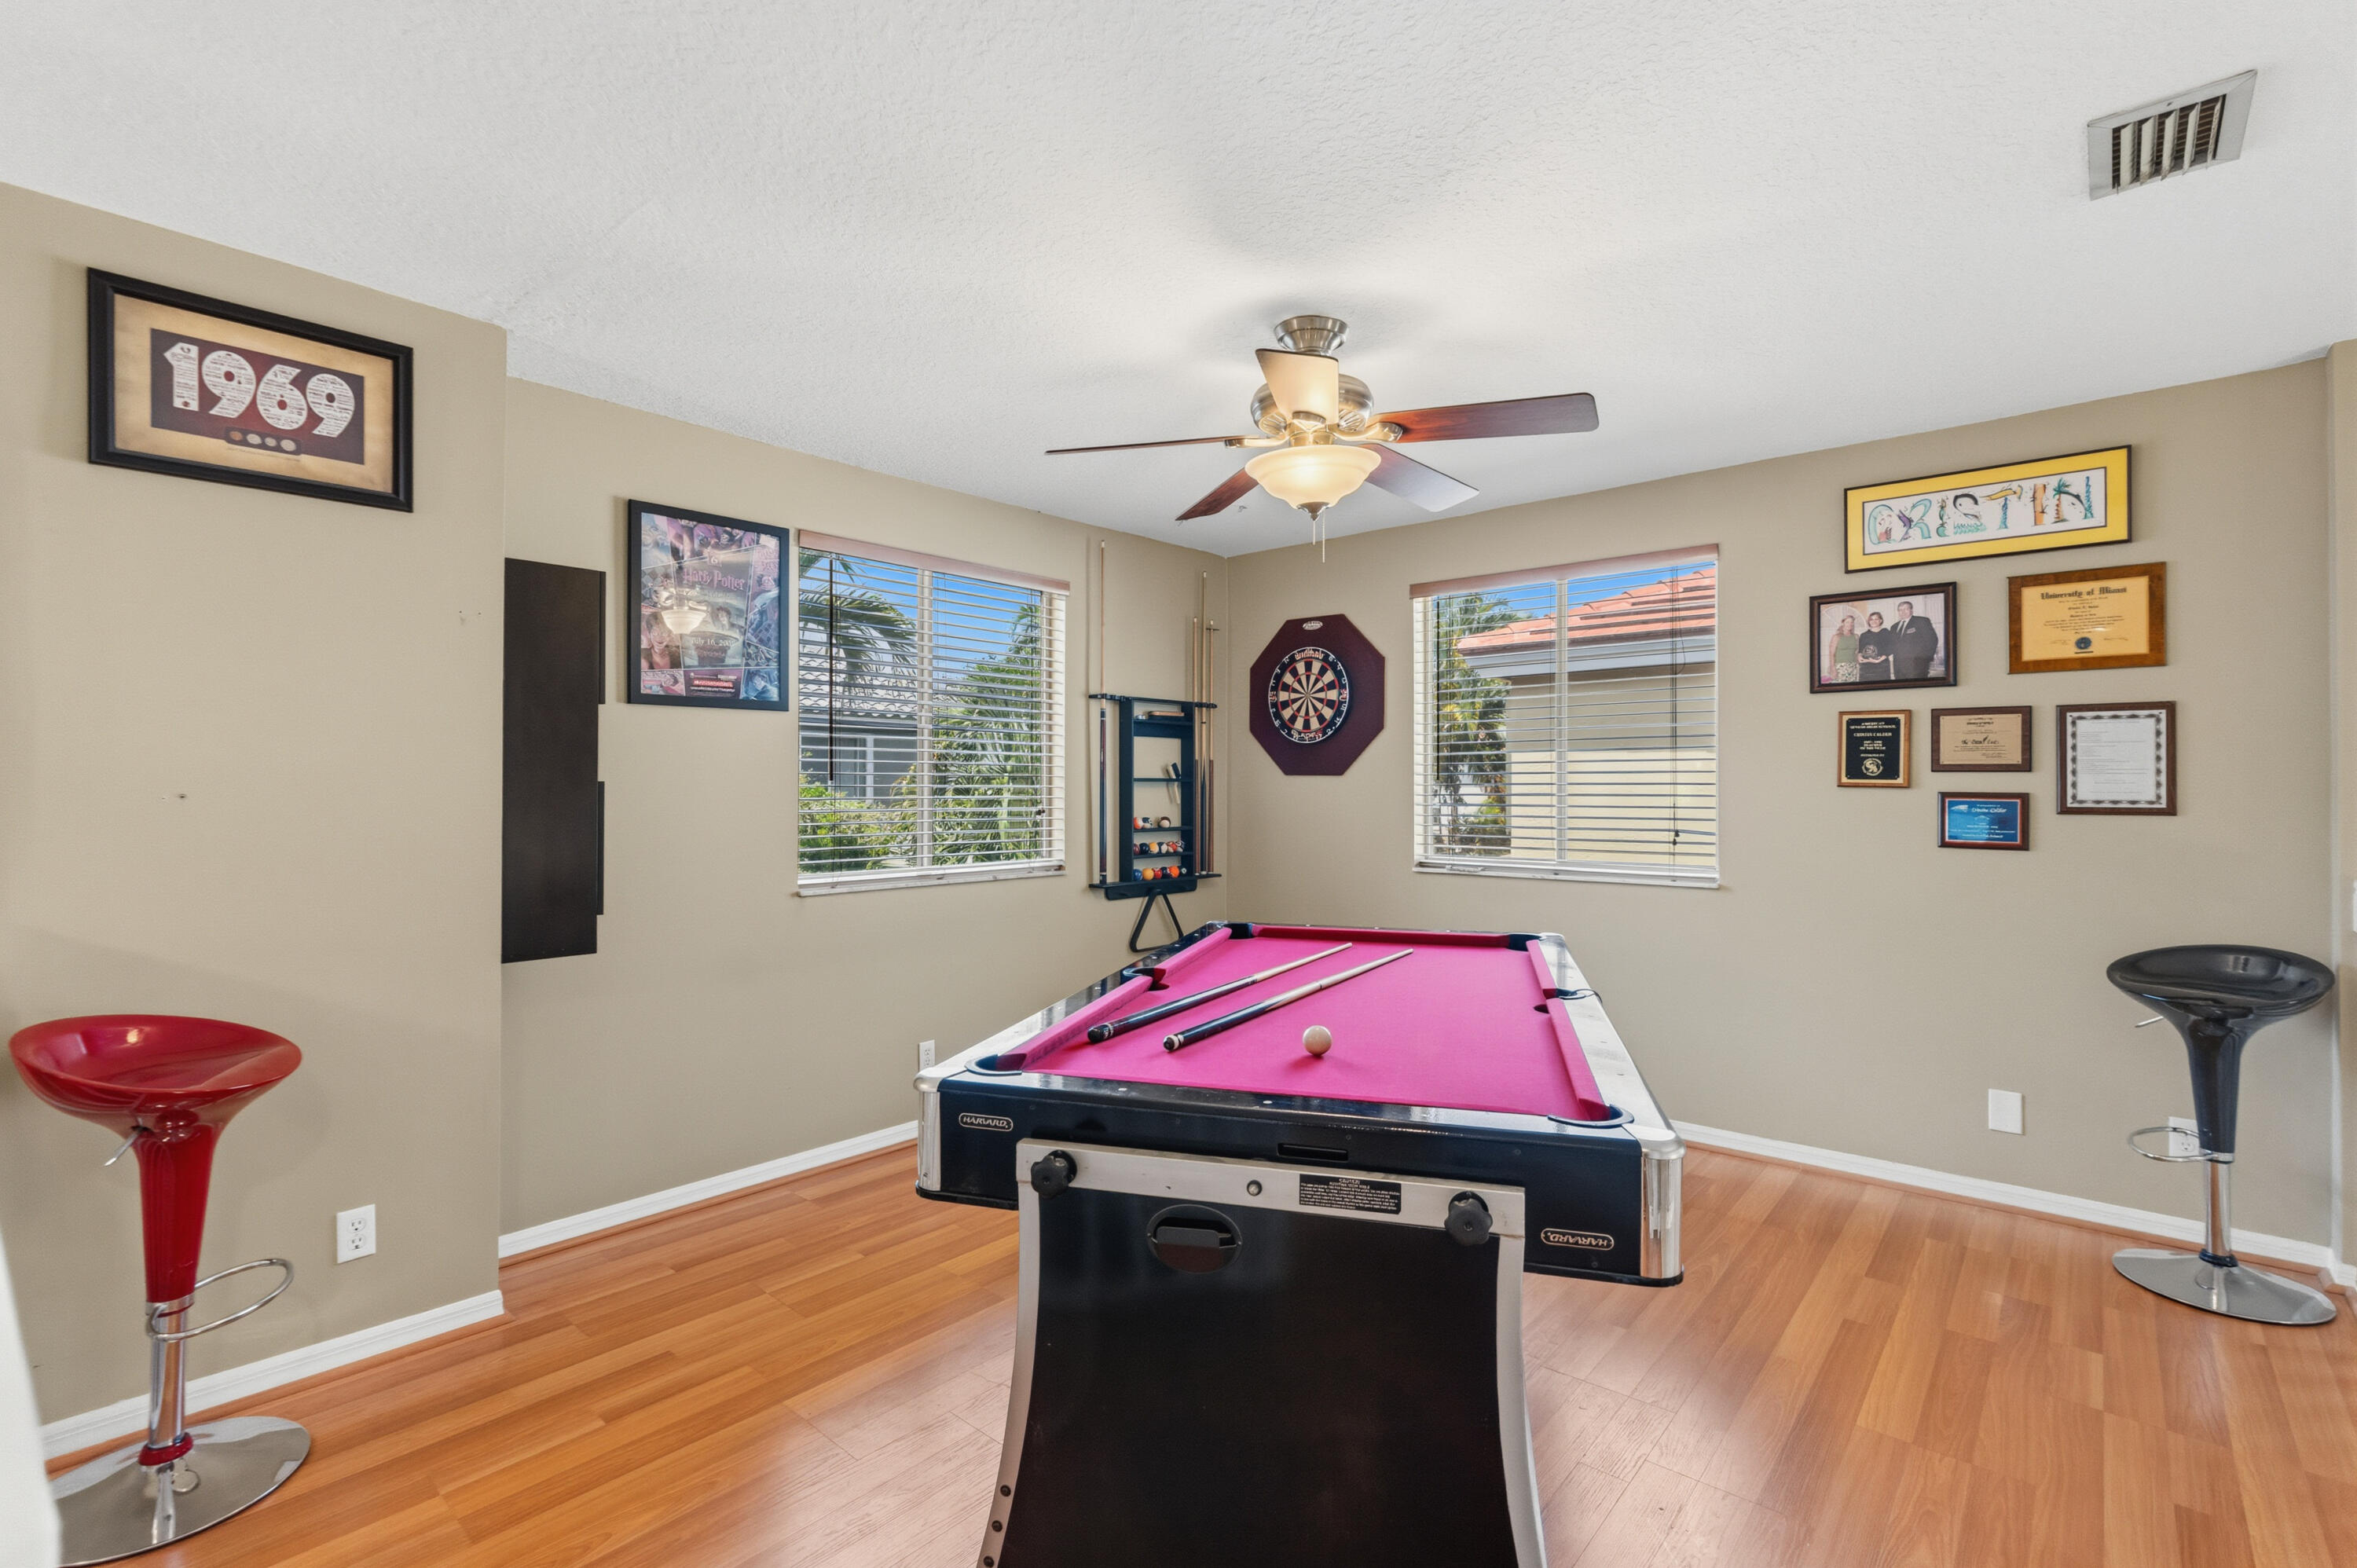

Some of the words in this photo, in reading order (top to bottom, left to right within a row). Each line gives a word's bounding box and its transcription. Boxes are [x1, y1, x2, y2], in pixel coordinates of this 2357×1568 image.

[163, 343, 355, 438] 1969
[682, 567, 712, 584] Harry
[713, 570, 745, 591] Potter
[2040, 591, 2083, 600] University
[963, 1116, 1007, 1127] HARVARD
[1549, 1233, 1607, 1246] HARVARD
